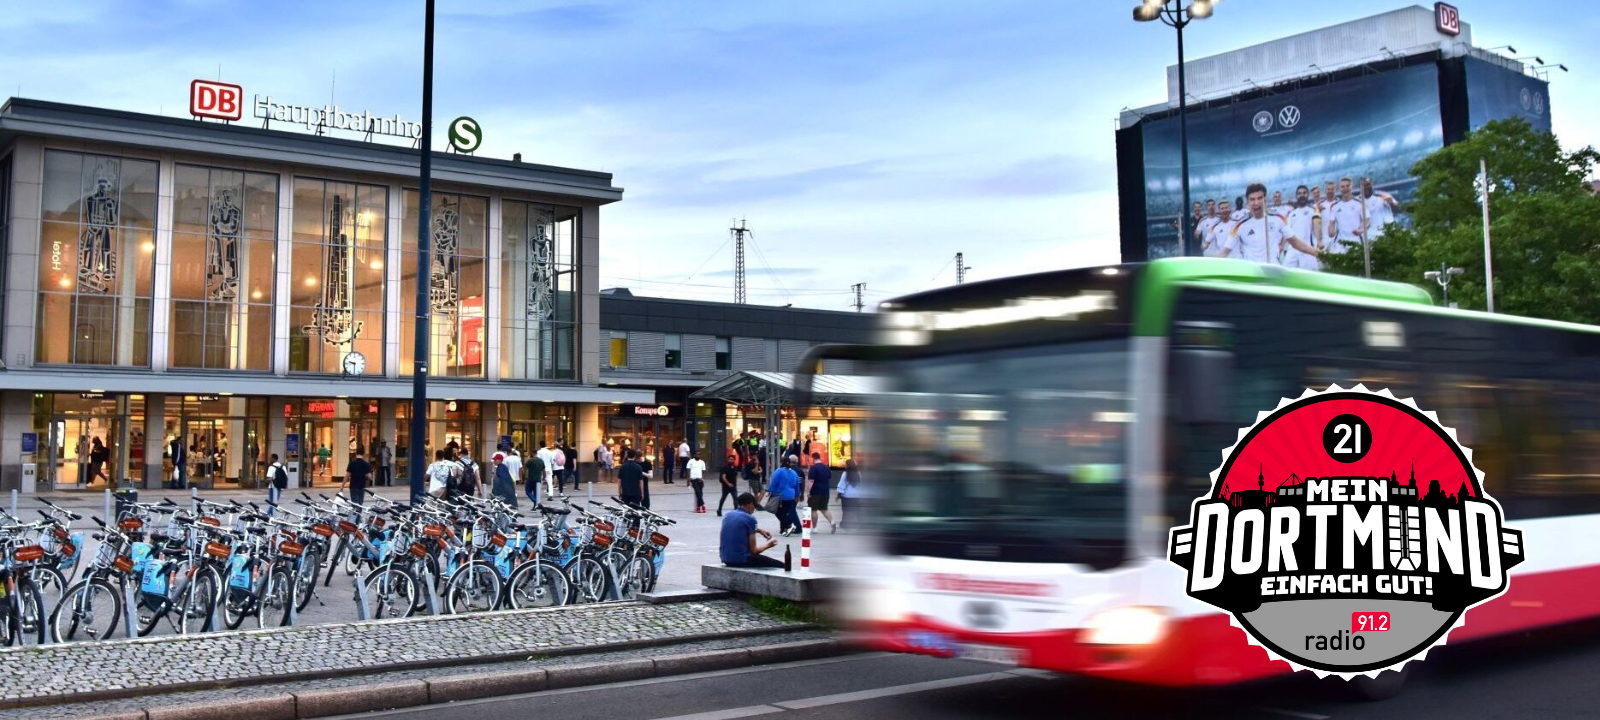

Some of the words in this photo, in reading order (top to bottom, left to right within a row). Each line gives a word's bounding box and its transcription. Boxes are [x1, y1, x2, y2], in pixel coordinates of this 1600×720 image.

[1441, 6, 1457, 29] DB
[198, 86, 236, 113] DB
[254, 93, 424, 139] Hauptbahnho
[455, 120, 477, 150] S
